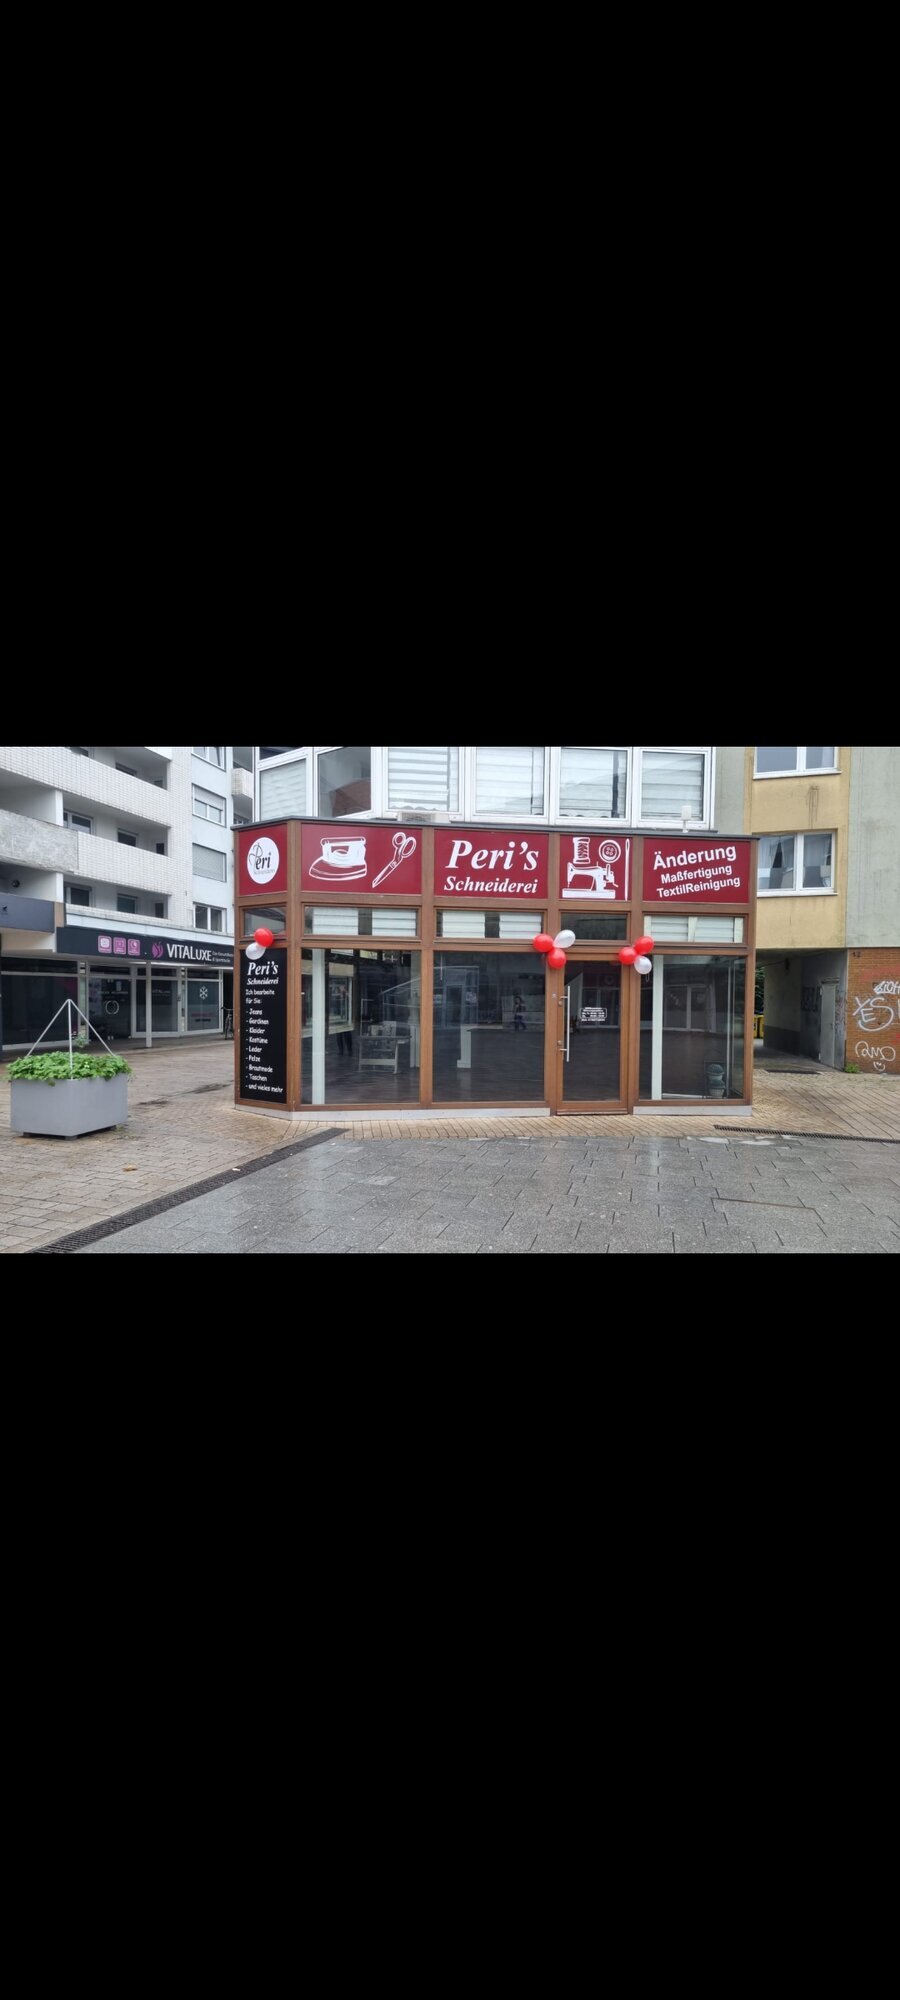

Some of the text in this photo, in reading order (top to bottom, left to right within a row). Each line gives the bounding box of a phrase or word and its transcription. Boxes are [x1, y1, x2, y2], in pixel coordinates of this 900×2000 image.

[249, 843, 271, 870] Peri
[445, 840, 539, 871] Peri's
[653, 846, 737, 871] Änderung
[660, 865, 733, 884] Maßfertigung
[443, 875, 538, 894] Schneiderei
[656, 877, 741, 898] TextilReinigung
[247, 960, 279, 975] Peri's
[246, 977, 279, 985] Schneiderei
[249, 1017, 269, 1025] Gardinen
[249, 1036, 268, 1044] Kostüme
[248, 1045, 262, 1053] Leder
[248, 1064, 273, 1073] Brautmode
[249, 1073, 267, 1082] Taschen
[257, 1084, 270, 1092] vieles
